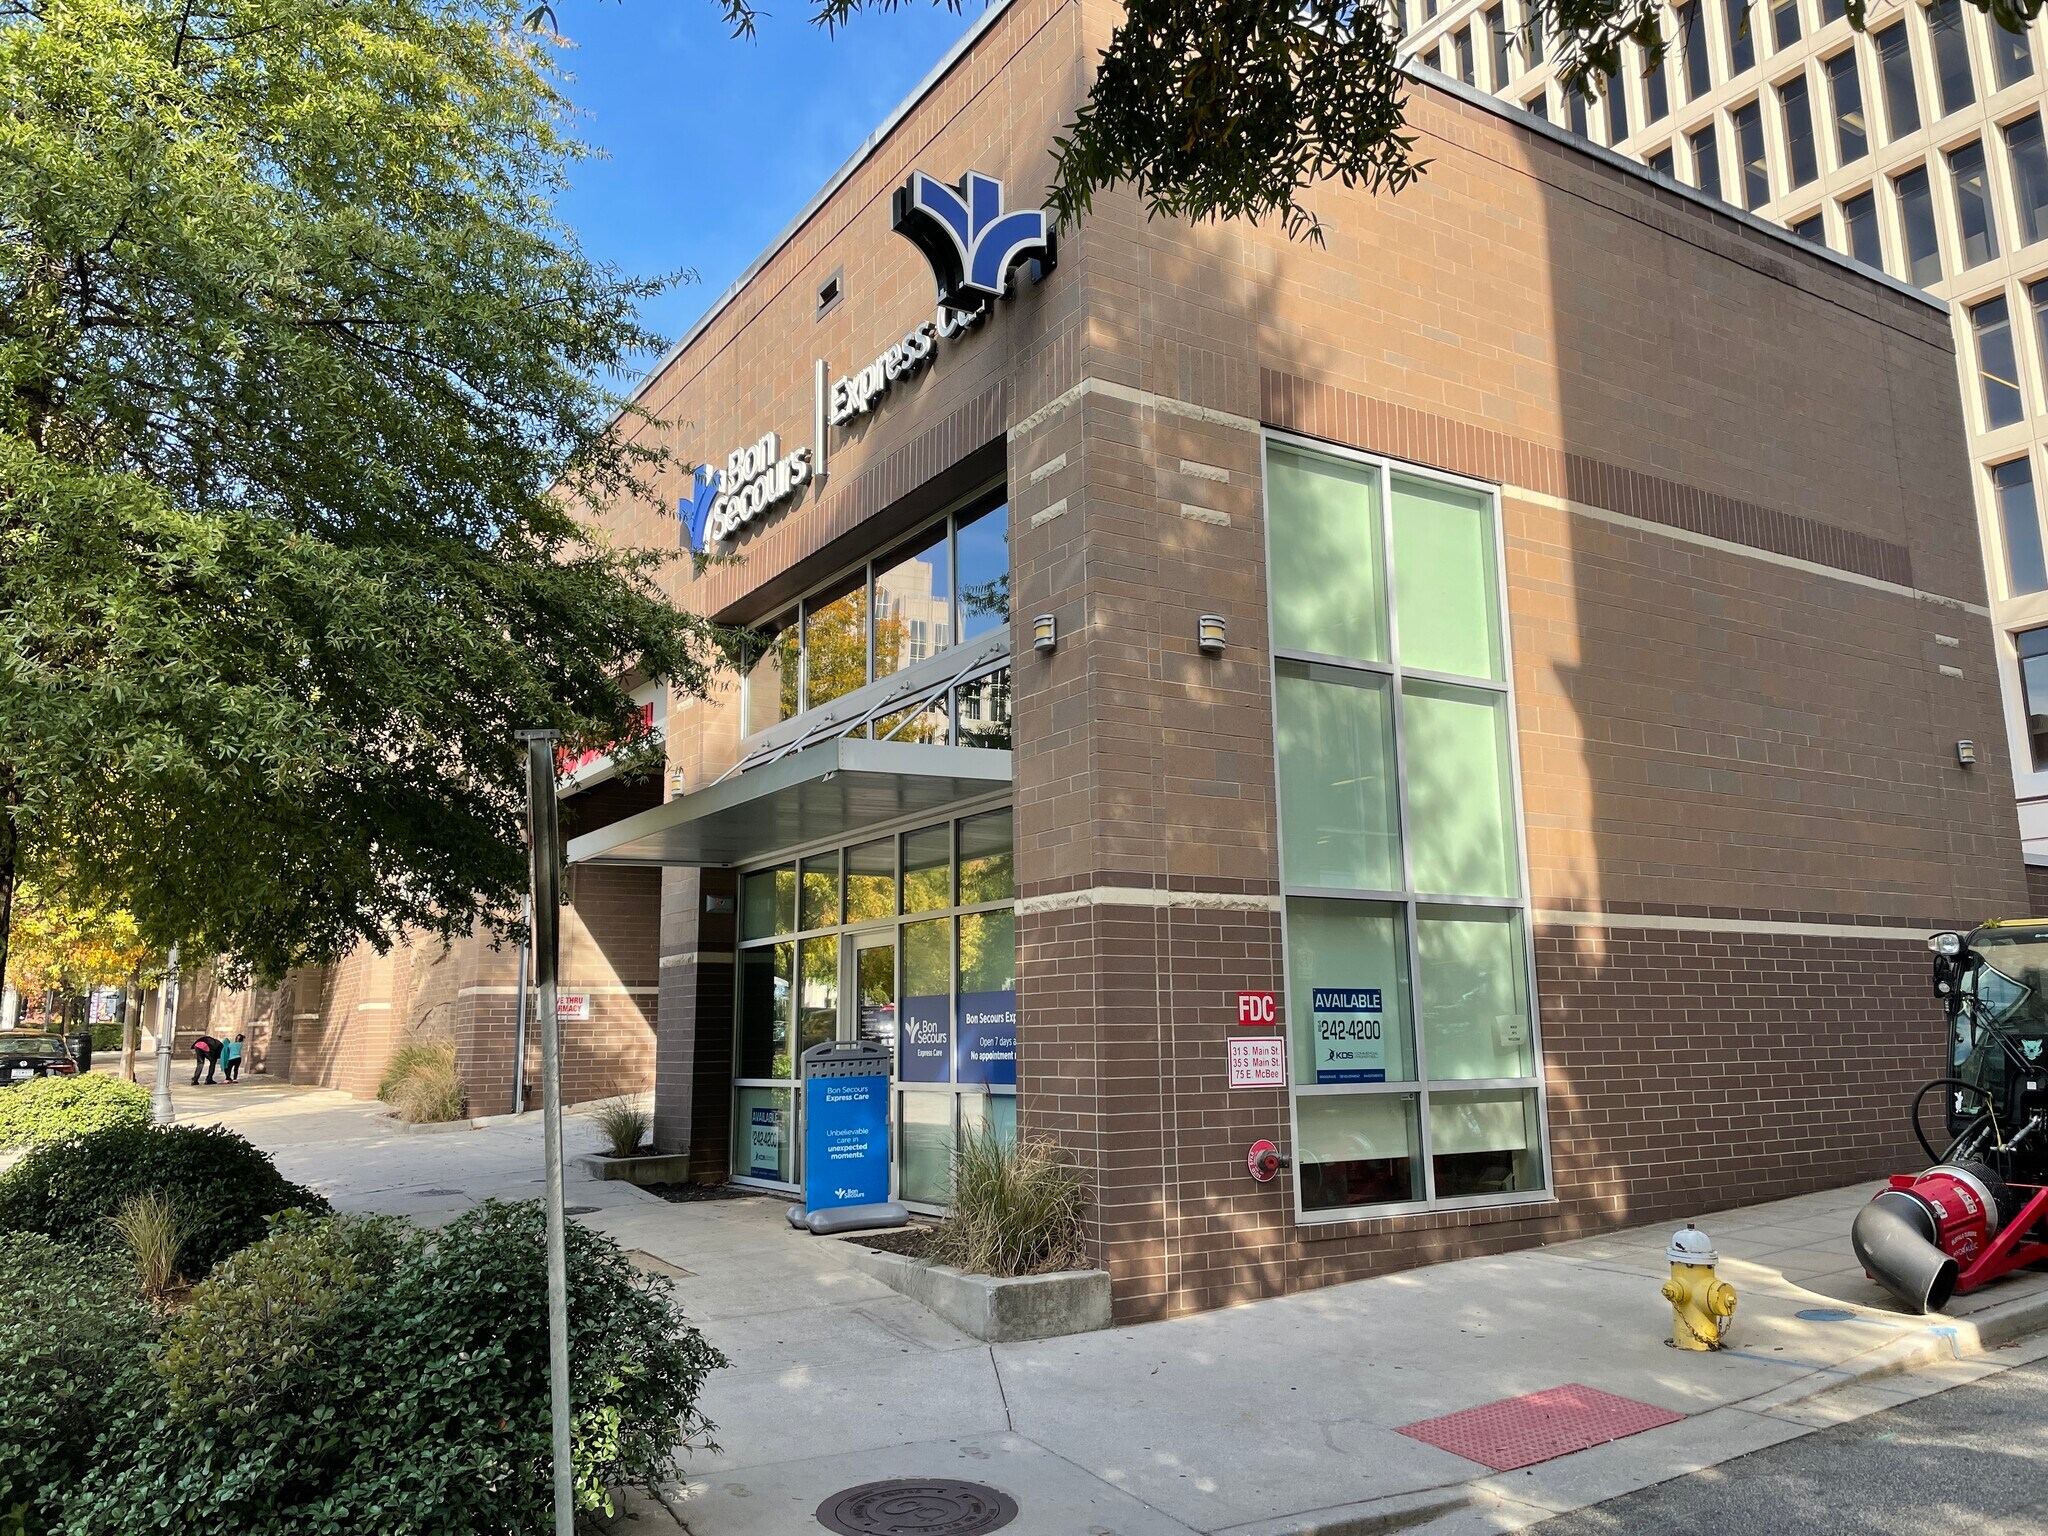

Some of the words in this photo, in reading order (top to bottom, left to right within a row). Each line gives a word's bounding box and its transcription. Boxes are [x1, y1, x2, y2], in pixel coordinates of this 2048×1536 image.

[830, 320, 937, 427] Express
[728, 431, 781, 495] Bon
[713, 446, 813, 541] Secours
[1315, 994, 1381, 1008] AVAILABLE
[1238, 995, 1274, 1022] FDC
[966, 1013, 978, 1024] Bon
[979, 1012, 1004, 1024] Secours
[922, 1020, 938, 1033] Bon
[1321, 1020, 1381, 1040] 242-4200
[917, 1032, 947, 1044] Secours
[980, 1037, 994, 1047] Open
[995, 1037, 999, 1045] 7
[1000, 1036, 1012, 1048] days
[917, 1048, 932, 1058] Express
[933, 1048, 943, 1057] Care
[970, 1051, 978, 1061] No
[979, 1050, 1014, 1062] appointment
[1232, 1047, 1241, 1056] 31
[1252, 1046, 1269, 1056] Main
[1233, 1058, 1242, 1068] 35
[1252, 1058, 1270, 1067] Main
[1235, 1070, 1245, 1079] 75
[1255, 1069, 1279, 1079] McBee
[827, 1087, 841, 1095] Bon
[842, 1086, 869, 1094] Secours
[826, 1094, 853, 1103] Express
[853, 1093, 870, 1101] Care
[752, 1111, 778, 1122] AVAILABLE
[826, 1127, 869, 1137] Unbelievable
[837, 1136, 852, 1144] care
[828, 1143, 868, 1152] unexpected
[831, 1151, 865, 1160] moments.
